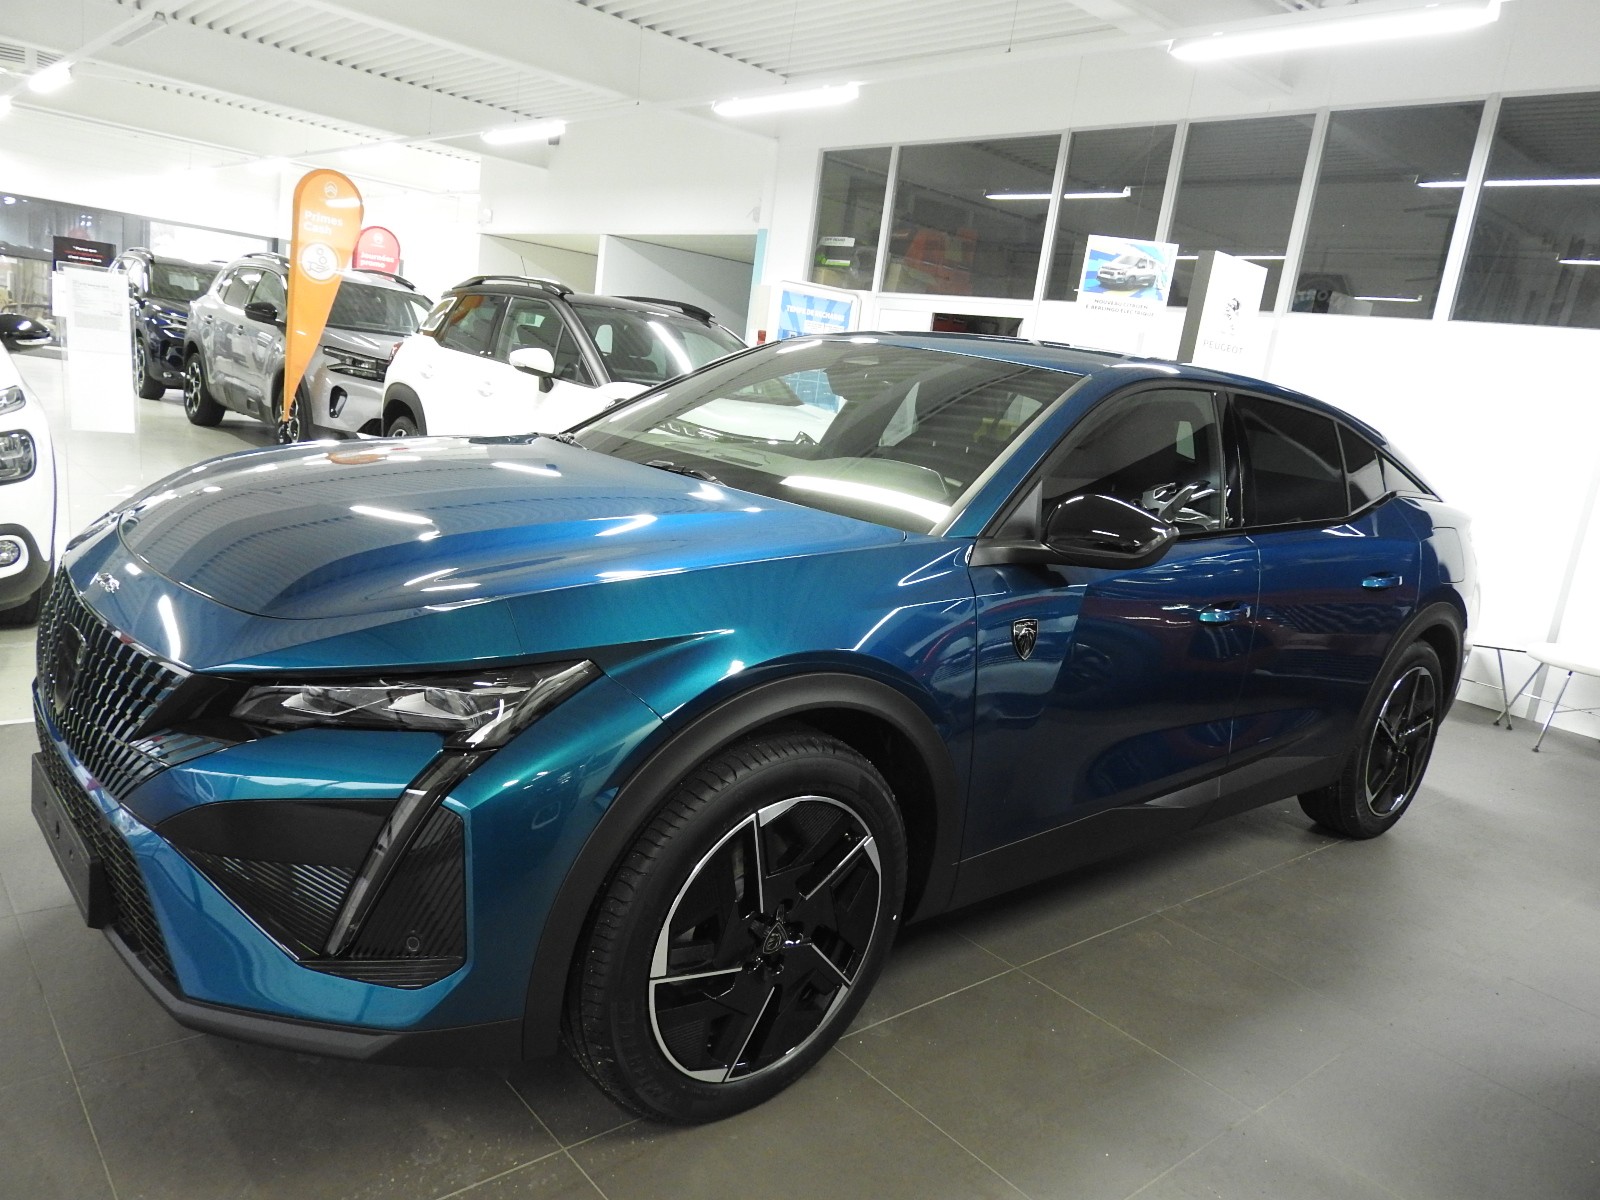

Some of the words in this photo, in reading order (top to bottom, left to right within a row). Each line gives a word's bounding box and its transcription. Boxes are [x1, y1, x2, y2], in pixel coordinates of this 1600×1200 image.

[304, 210, 343, 226] Primes
[304, 222, 332, 235] Cash
[360, 260, 386, 268] promo
[1094, 299, 1122, 307] NOUVEAU
[1203, 339, 1244, 354] PEUGEOT
